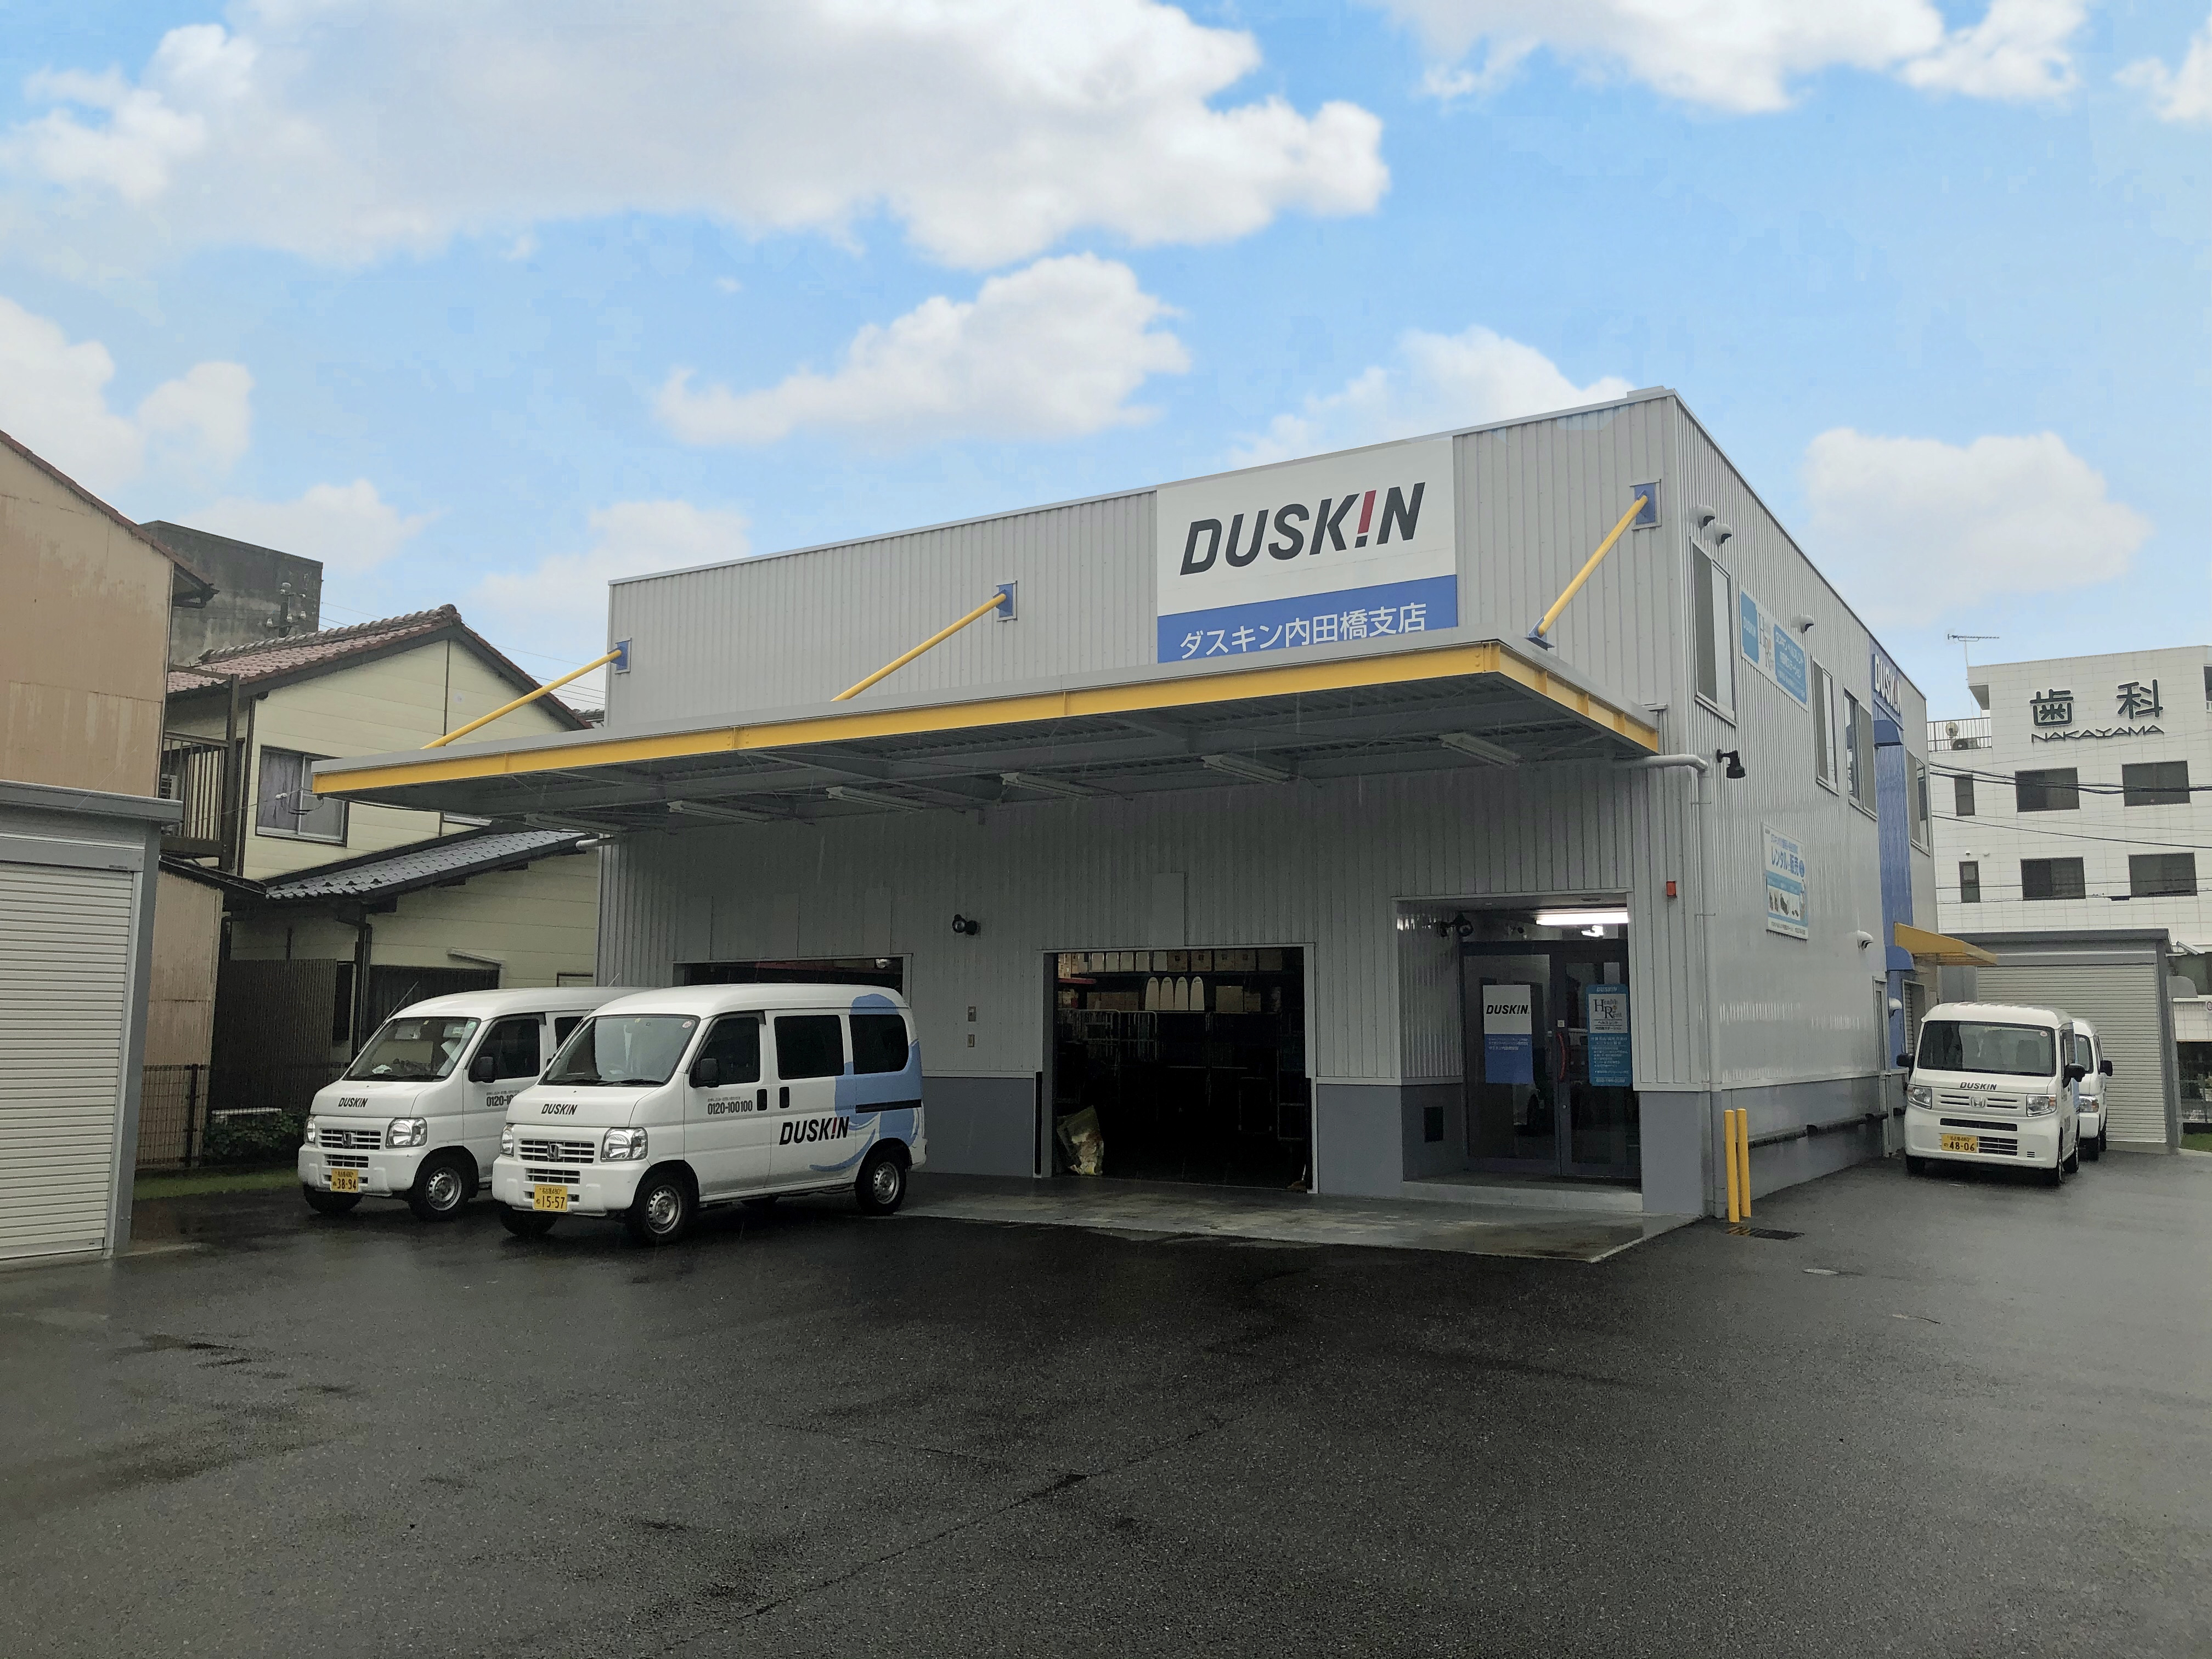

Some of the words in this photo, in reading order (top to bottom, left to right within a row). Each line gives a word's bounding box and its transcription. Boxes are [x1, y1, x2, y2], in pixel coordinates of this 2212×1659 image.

[1180, 602, 1427, 659] ダスキン内田橋支店
[2031, 725, 2165, 743] NAKAYAMA
[707, 1099, 753, 1115] 0120-100100
[1949, 1141, 1975, 1152] 48-06
[337, 1178, 357, 1190] 38-94
[542, 1195, 565, 1209] 15-57
